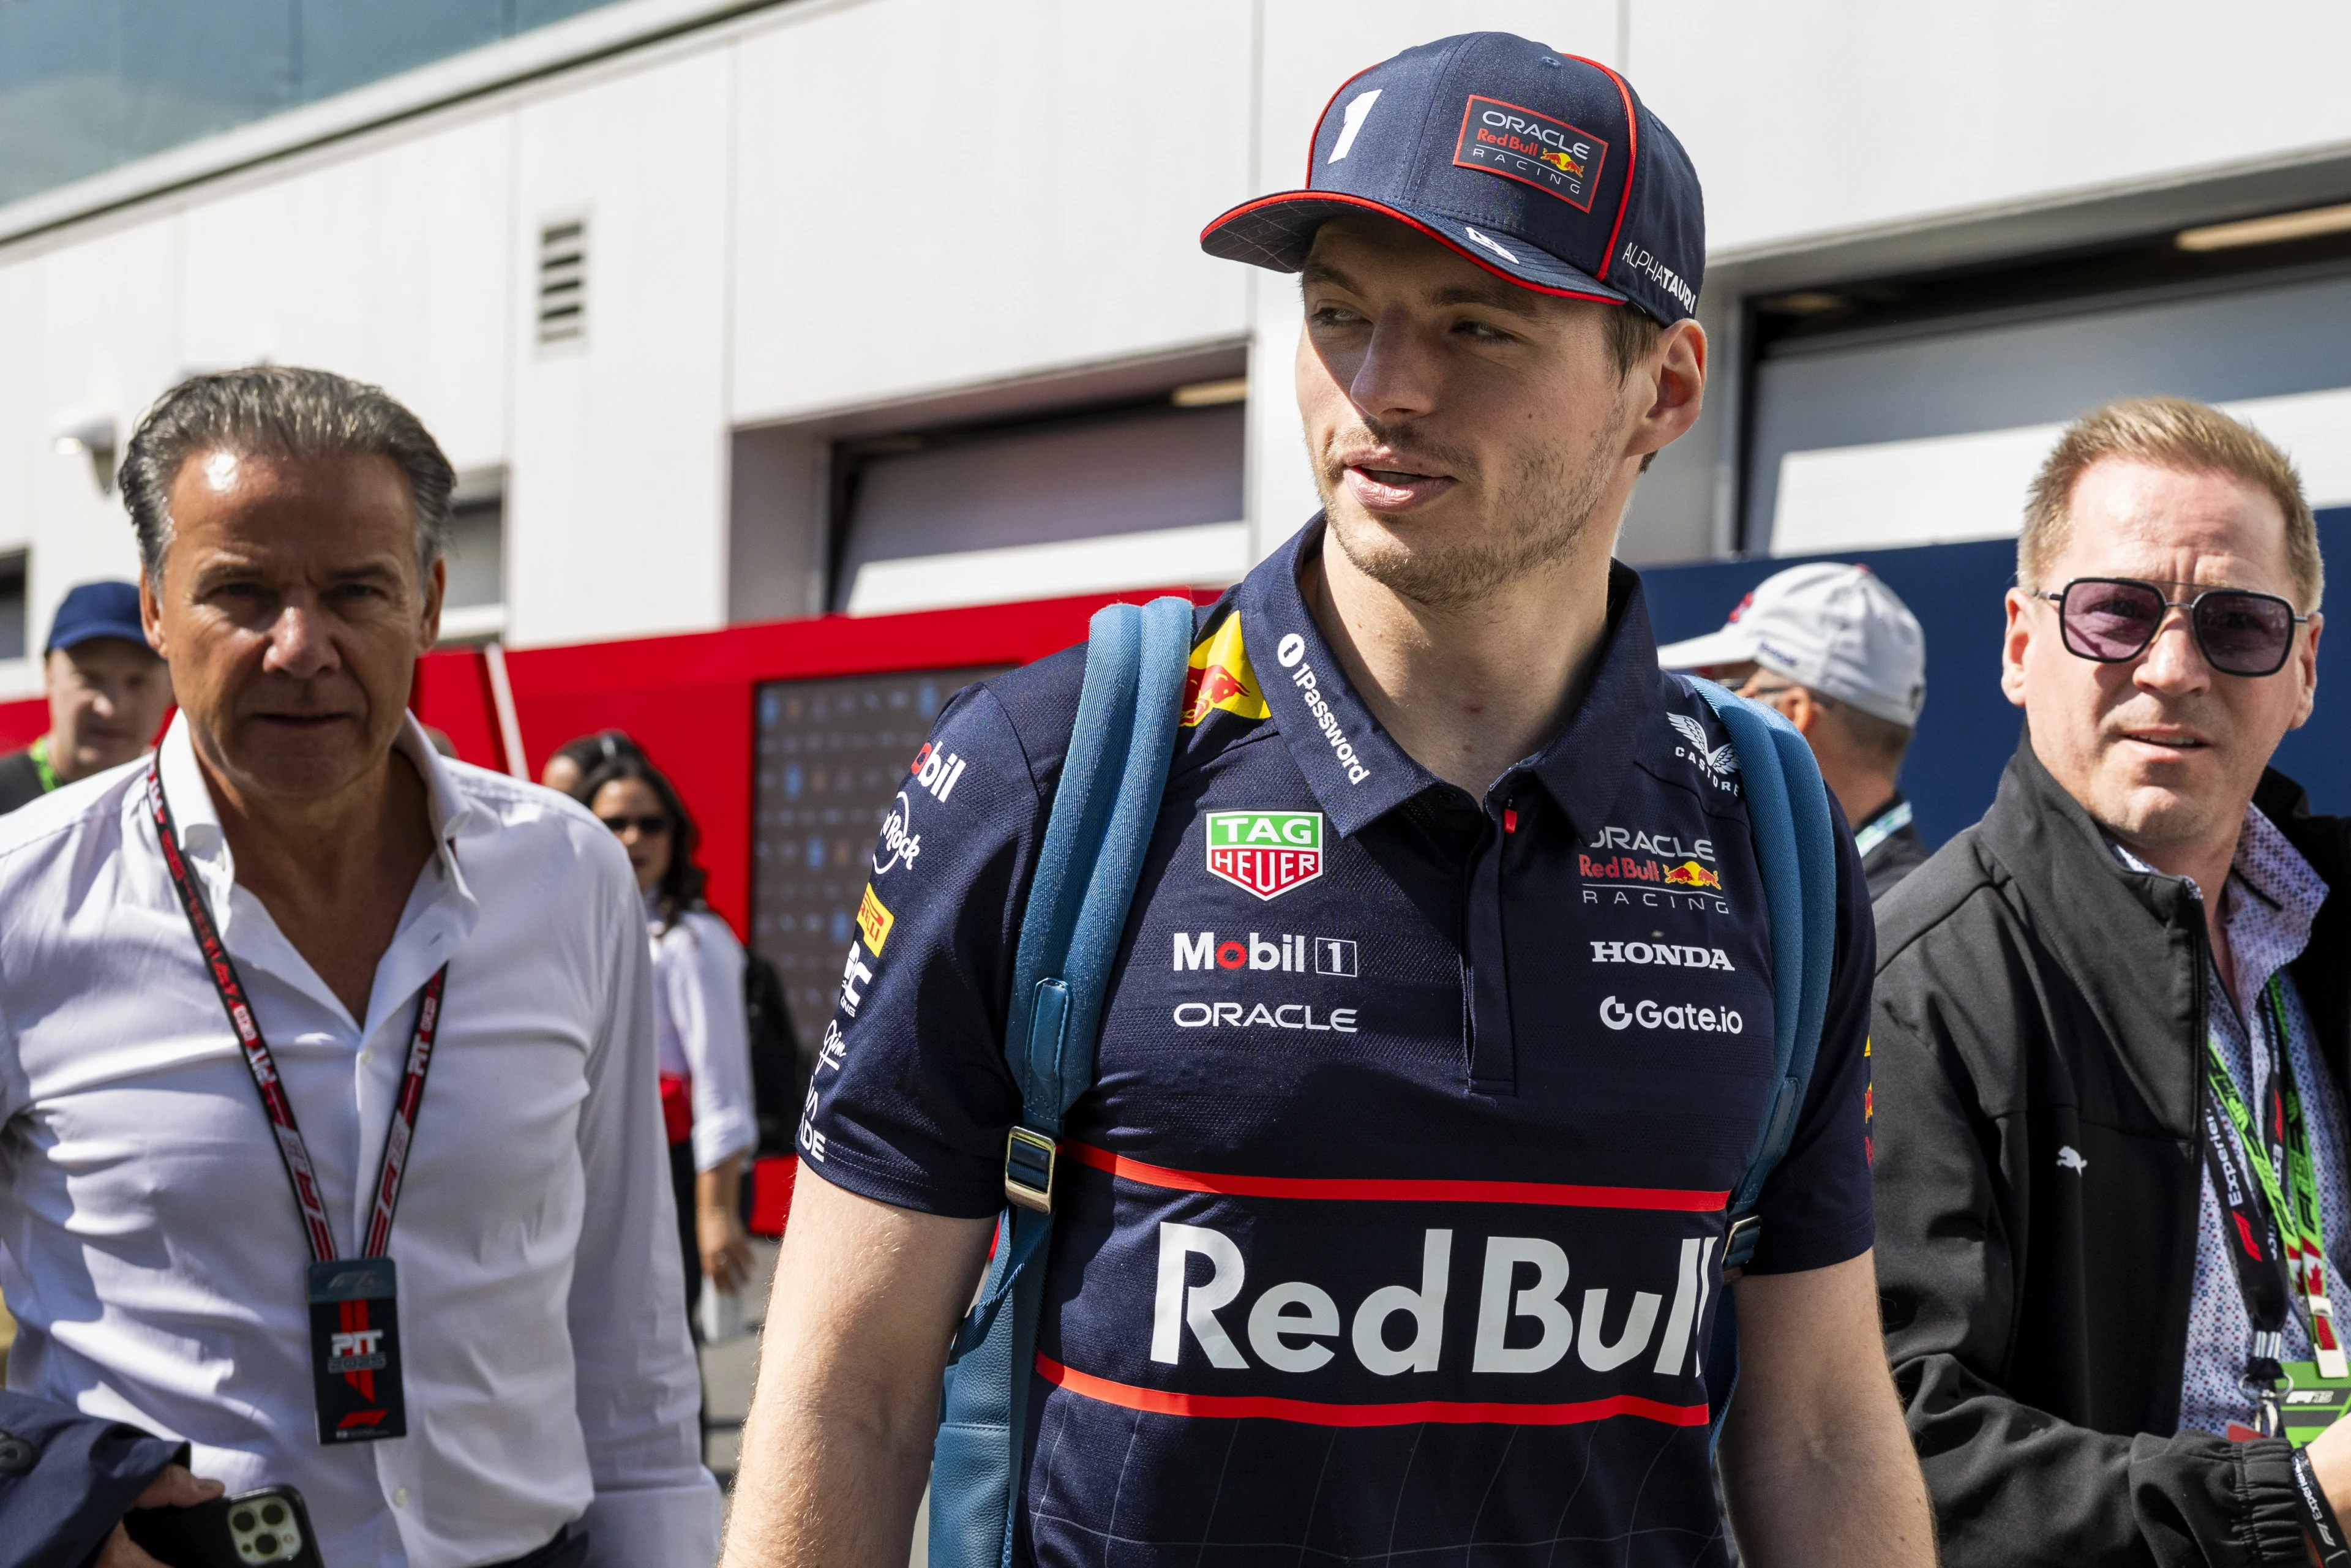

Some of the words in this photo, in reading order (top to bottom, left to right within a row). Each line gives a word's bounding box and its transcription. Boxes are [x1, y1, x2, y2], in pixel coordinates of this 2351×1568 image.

[1327, 89, 1383, 165] 1
[1476, 128, 1509, 147] Red
[1509, 136, 1539, 157] Bull
[1482, 111, 1591, 160] ORACLE
[1472, 148, 1581, 195] RACING
[1622, 242, 1697, 315] ALPHATAURI
[1292, 662, 1371, 786] 1Password
[911, 740, 967, 803] obil
[1675, 746, 1740, 797] CASTORE
[1217, 817, 1312, 845] TAG
[1215, 850, 1316, 893] HEUER
[1578, 854, 1620, 878] Red
[1621, 857, 1660, 882] Bull
[859, 899, 882, 942] RELLI
[1582, 890, 1730, 915] RACING
[1173, 932, 1305, 972] Mobil
[1327, 942, 1341, 972] 1
[1590, 942, 1736, 971] HONDA
[1173, 1002, 1359, 1033] ORACLE
[1635, 1000, 1742, 1035] Gate.io
[1150, 1222, 1453, 1376] Red
[331, 1329, 384, 1358] PIT
